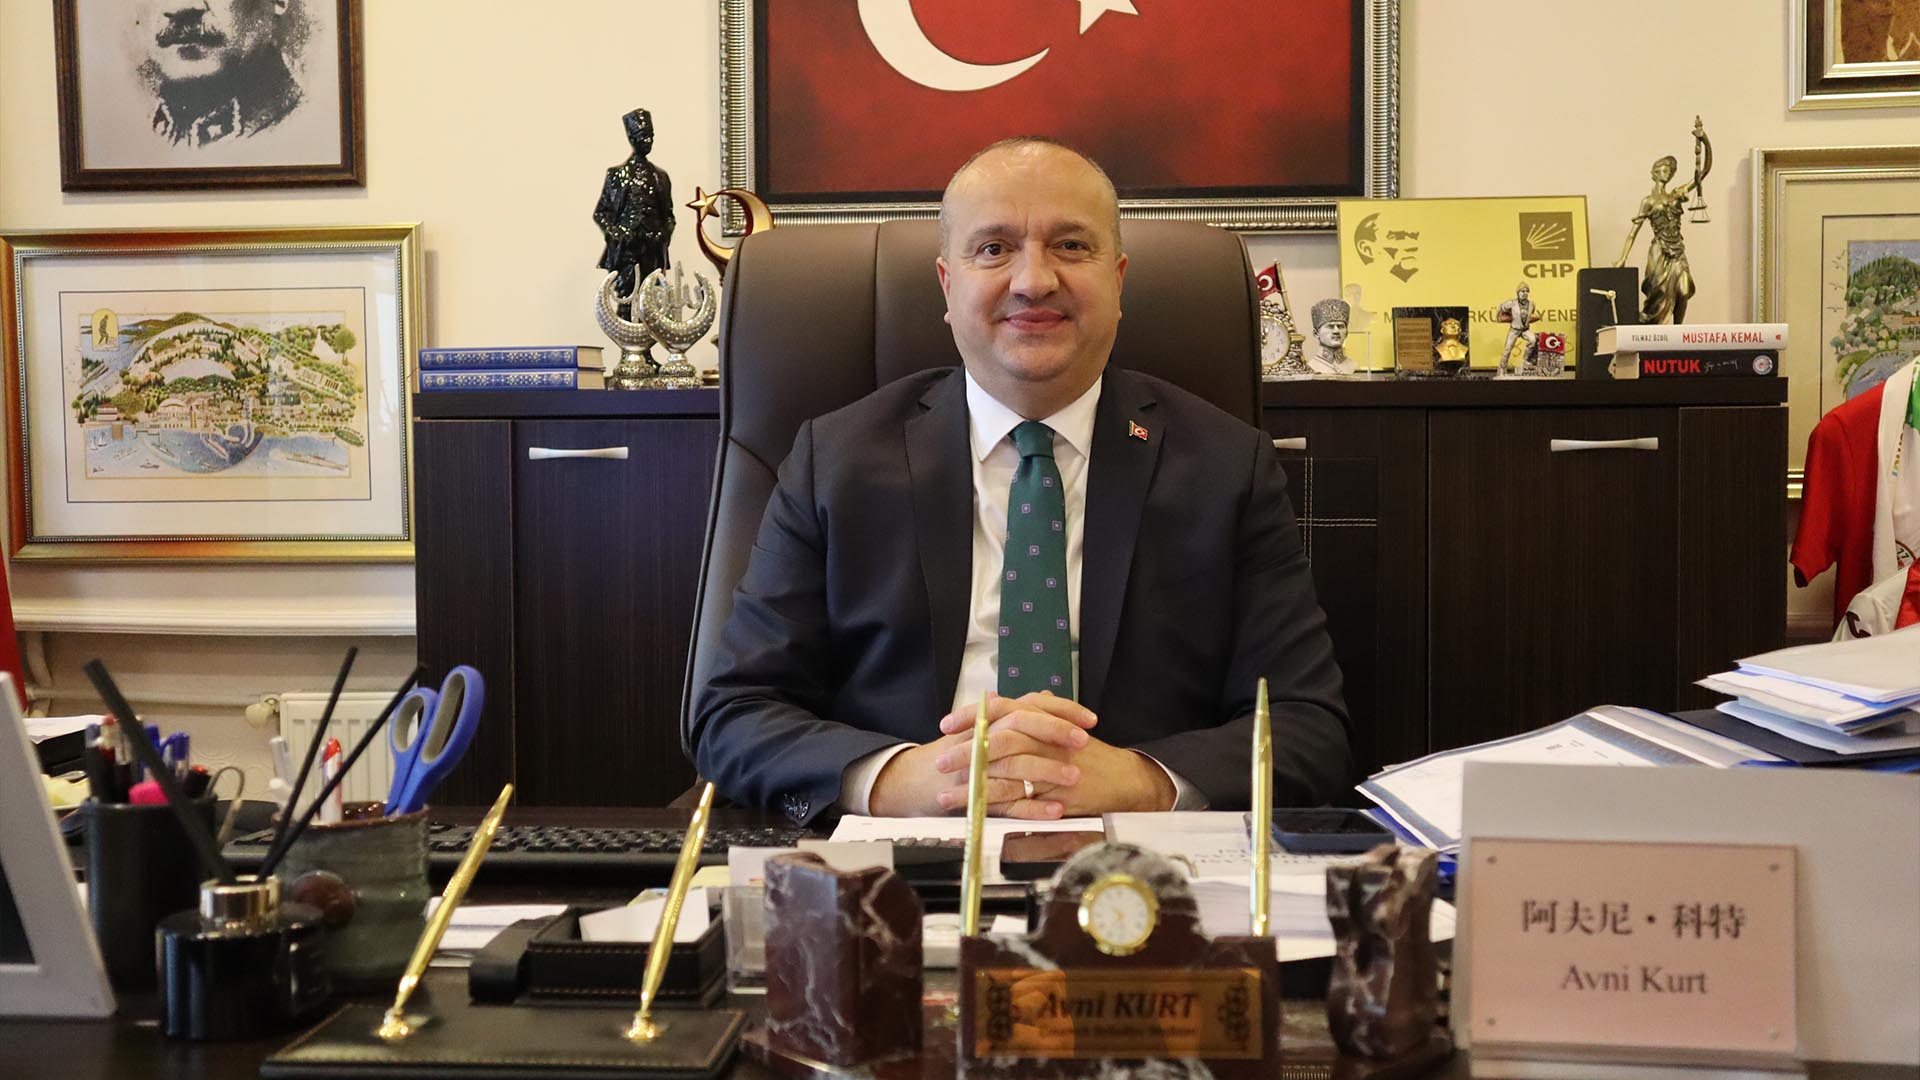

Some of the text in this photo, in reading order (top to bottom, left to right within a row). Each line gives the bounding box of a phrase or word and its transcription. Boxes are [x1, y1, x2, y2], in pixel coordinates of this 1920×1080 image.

[1523, 263, 1575, 279] CHP
[1682, 333, 1728, 344] MUSTAFA
[1731, 331, 1765, 343] KEMAL
[1644, 359, 1701, 374] NUTUK
[1561, 964, 1707, 995] Avni Kurt
[1040, 993, 1198, 1019] Avni KURT
